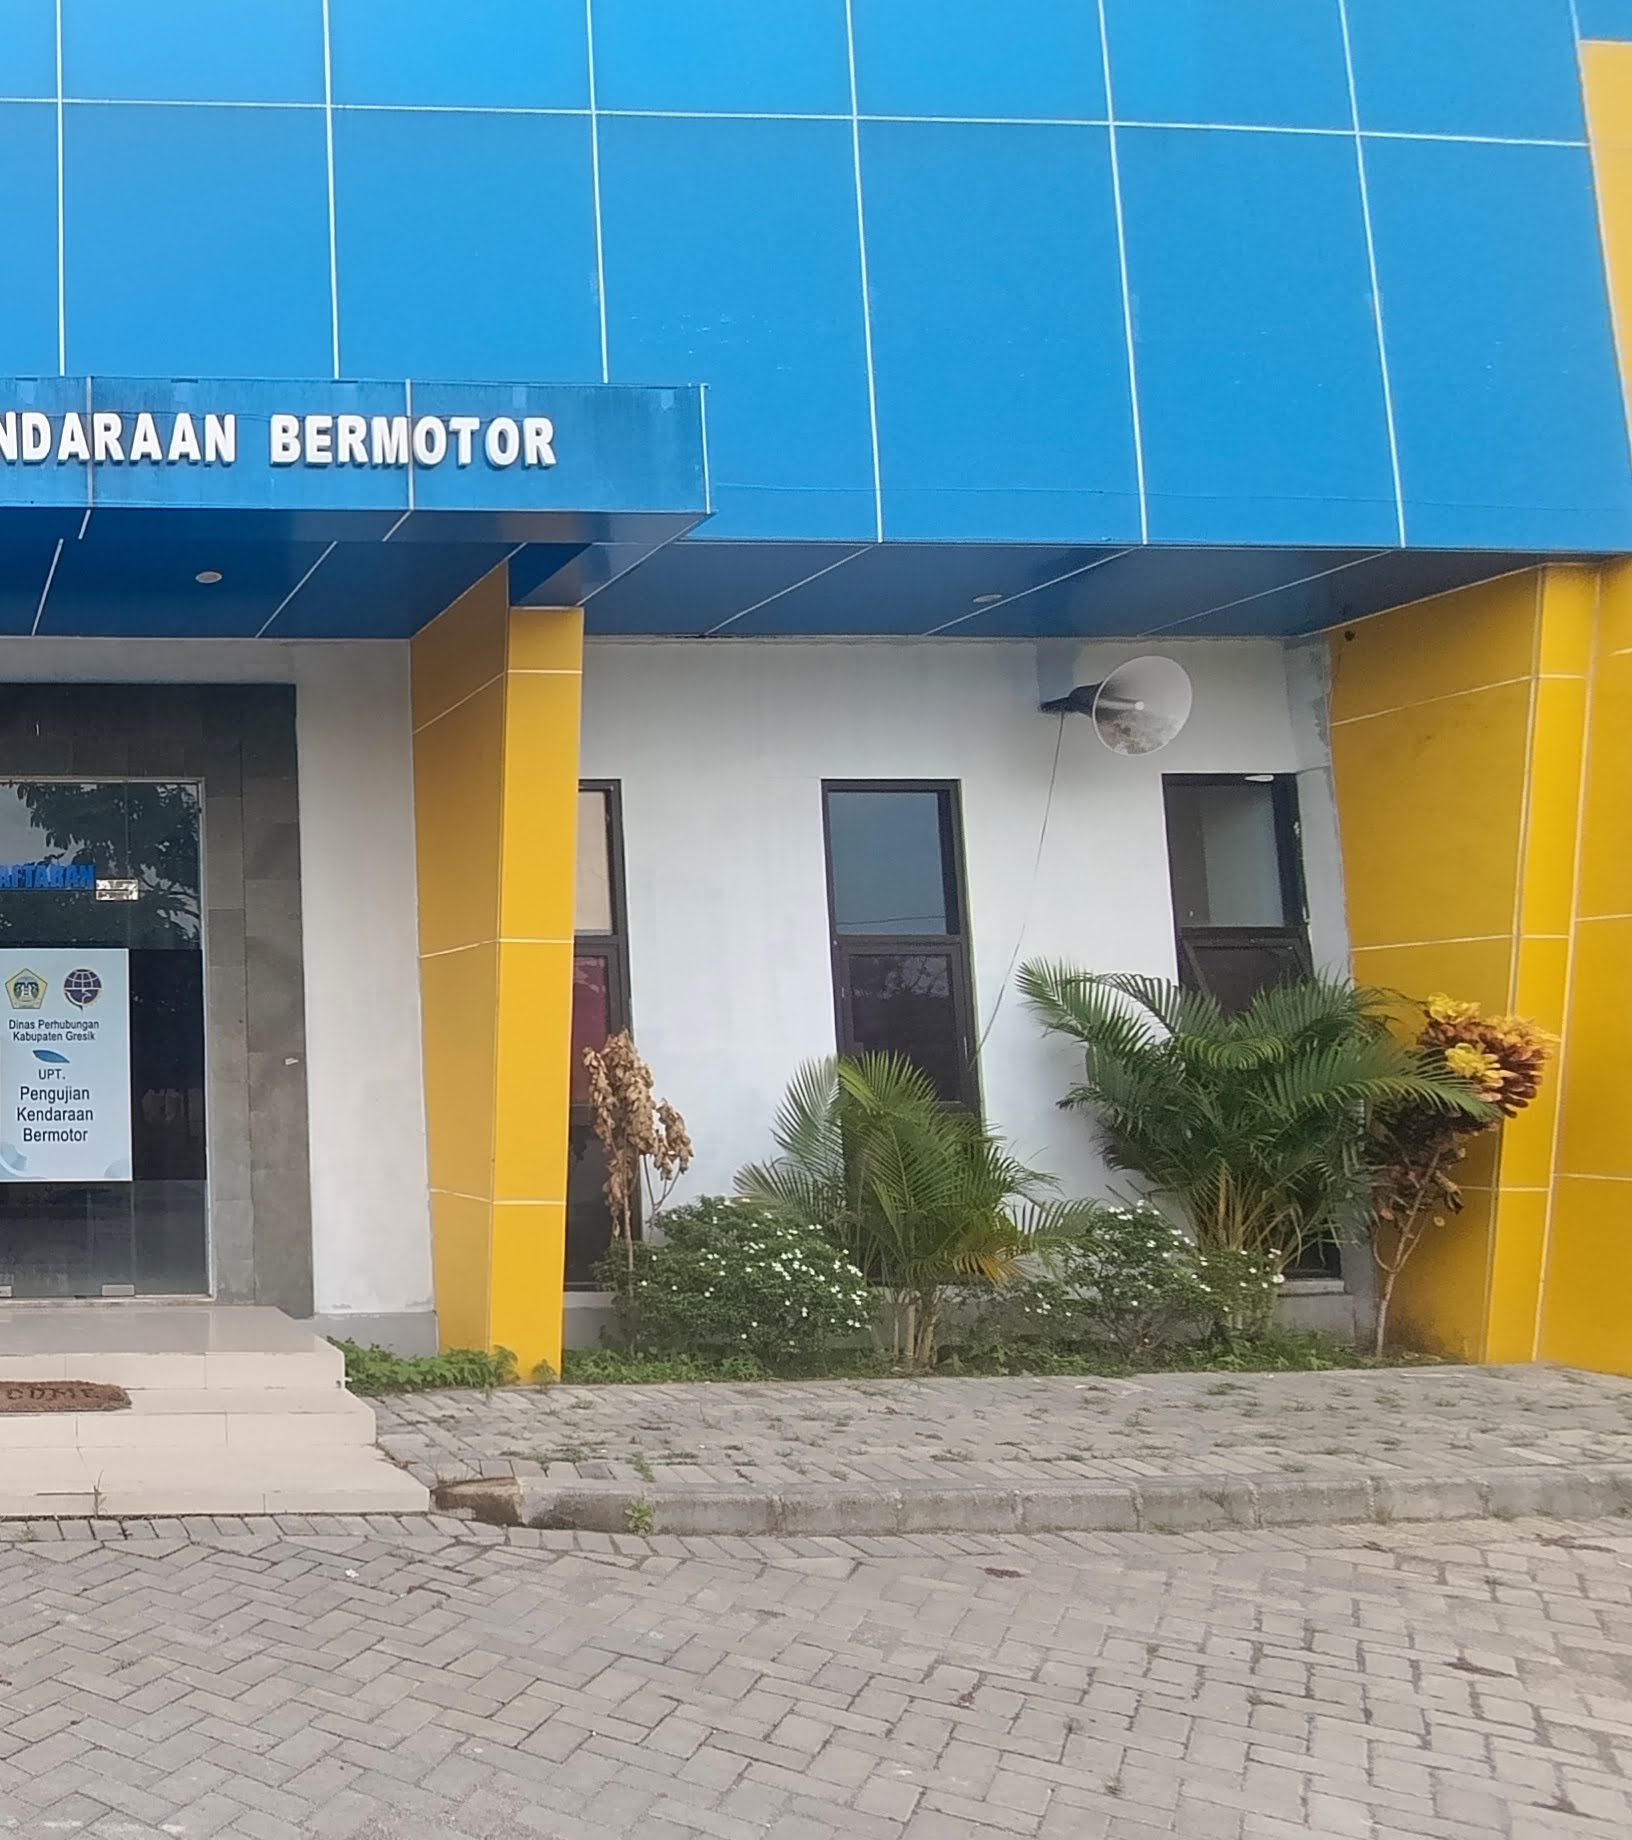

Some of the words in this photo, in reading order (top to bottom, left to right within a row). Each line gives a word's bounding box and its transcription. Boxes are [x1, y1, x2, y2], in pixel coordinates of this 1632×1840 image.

[270, 413, 557, 468] BERMOTOR
[9, 1019, 35, 1030] Dinas
[38, 1019, 99, 1034] Perhubungan
[13, 1032, 63, 1045] Kabupaten
[65, 1031, 96, 1042] Gresik
[38, 1068, 67, 1080] UPT.
[20, 1086, 90, 1104] Pengujian
[17, 1107, 94, 1121] Kendaraan
[23, 1128, 88, 1142] Bermotor
